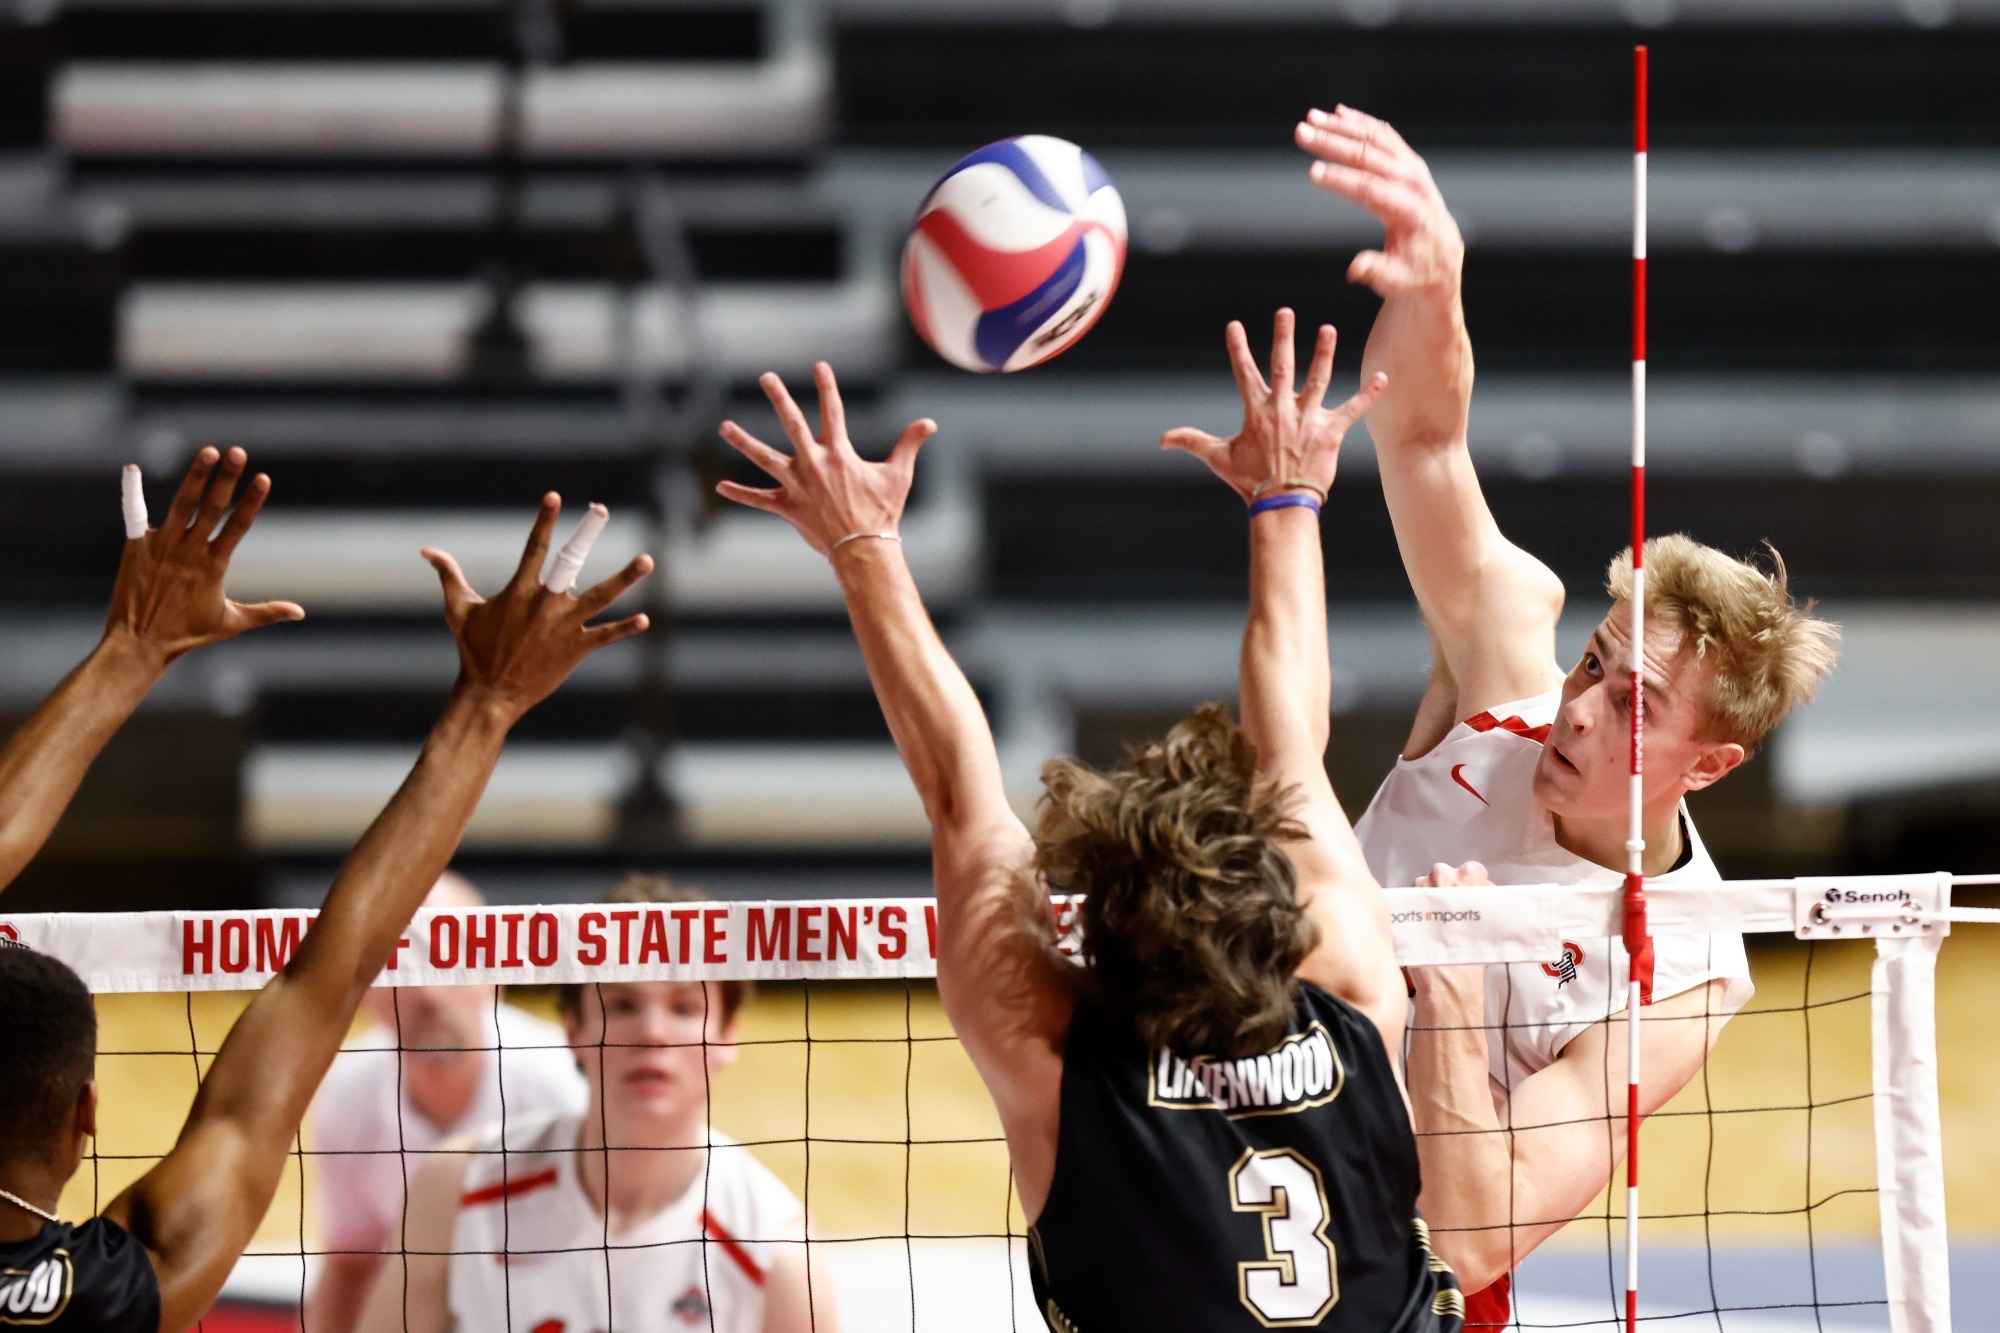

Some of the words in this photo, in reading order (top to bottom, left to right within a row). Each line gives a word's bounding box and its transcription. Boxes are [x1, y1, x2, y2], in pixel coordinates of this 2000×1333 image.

[1845, 889, 1910, 904] Senoh
[183, 917, 319, 975] HOM
[430, 913, 559, 968] OHIO
[577, 909, 728, 965] STATE
[747, 906, 907, 961] MEN'S
[1229, 1148, 1339, 1327] 3
